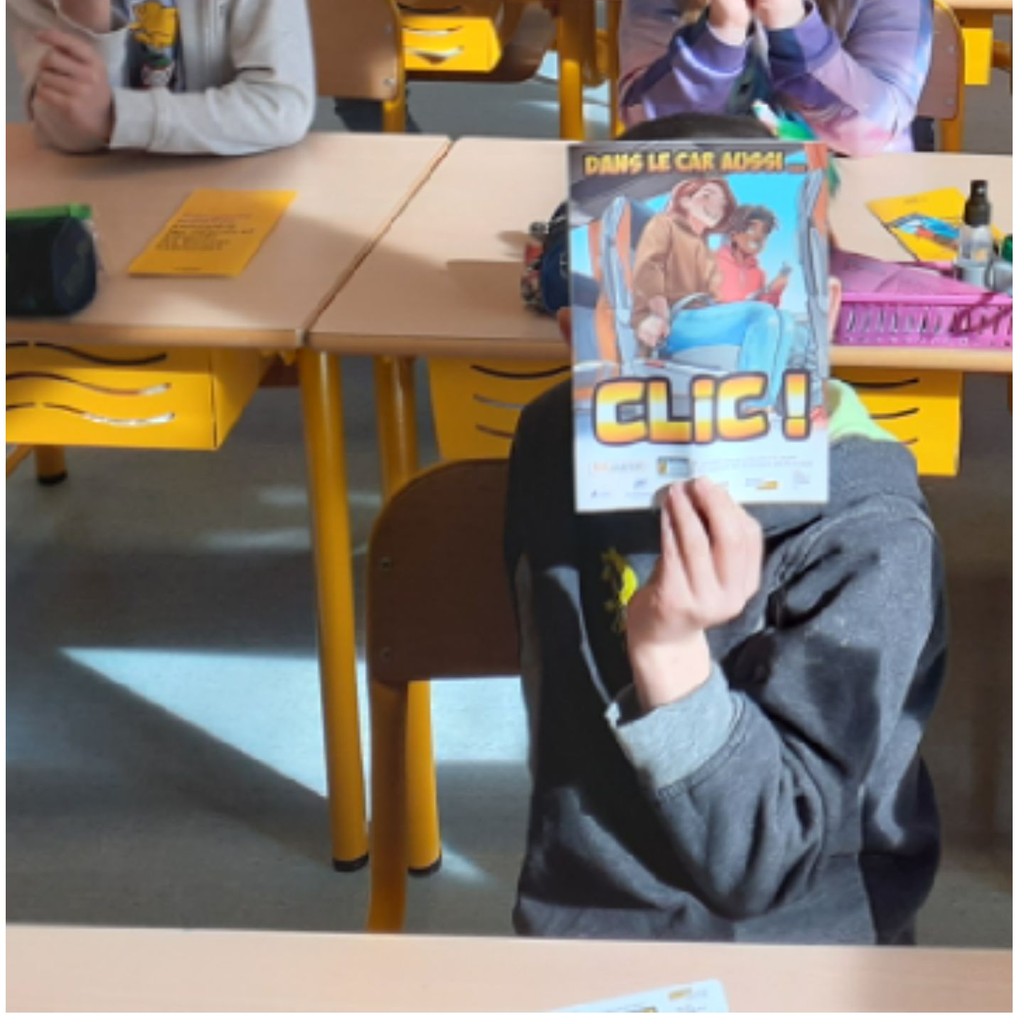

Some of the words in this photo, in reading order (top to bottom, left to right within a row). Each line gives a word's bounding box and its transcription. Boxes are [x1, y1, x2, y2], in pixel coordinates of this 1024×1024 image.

[584, 154, 643, 175] DANS
[647, 151, 671, 172] LE
[675, 150, 714, 171] CAR
[783, 369, 811, 442] !
